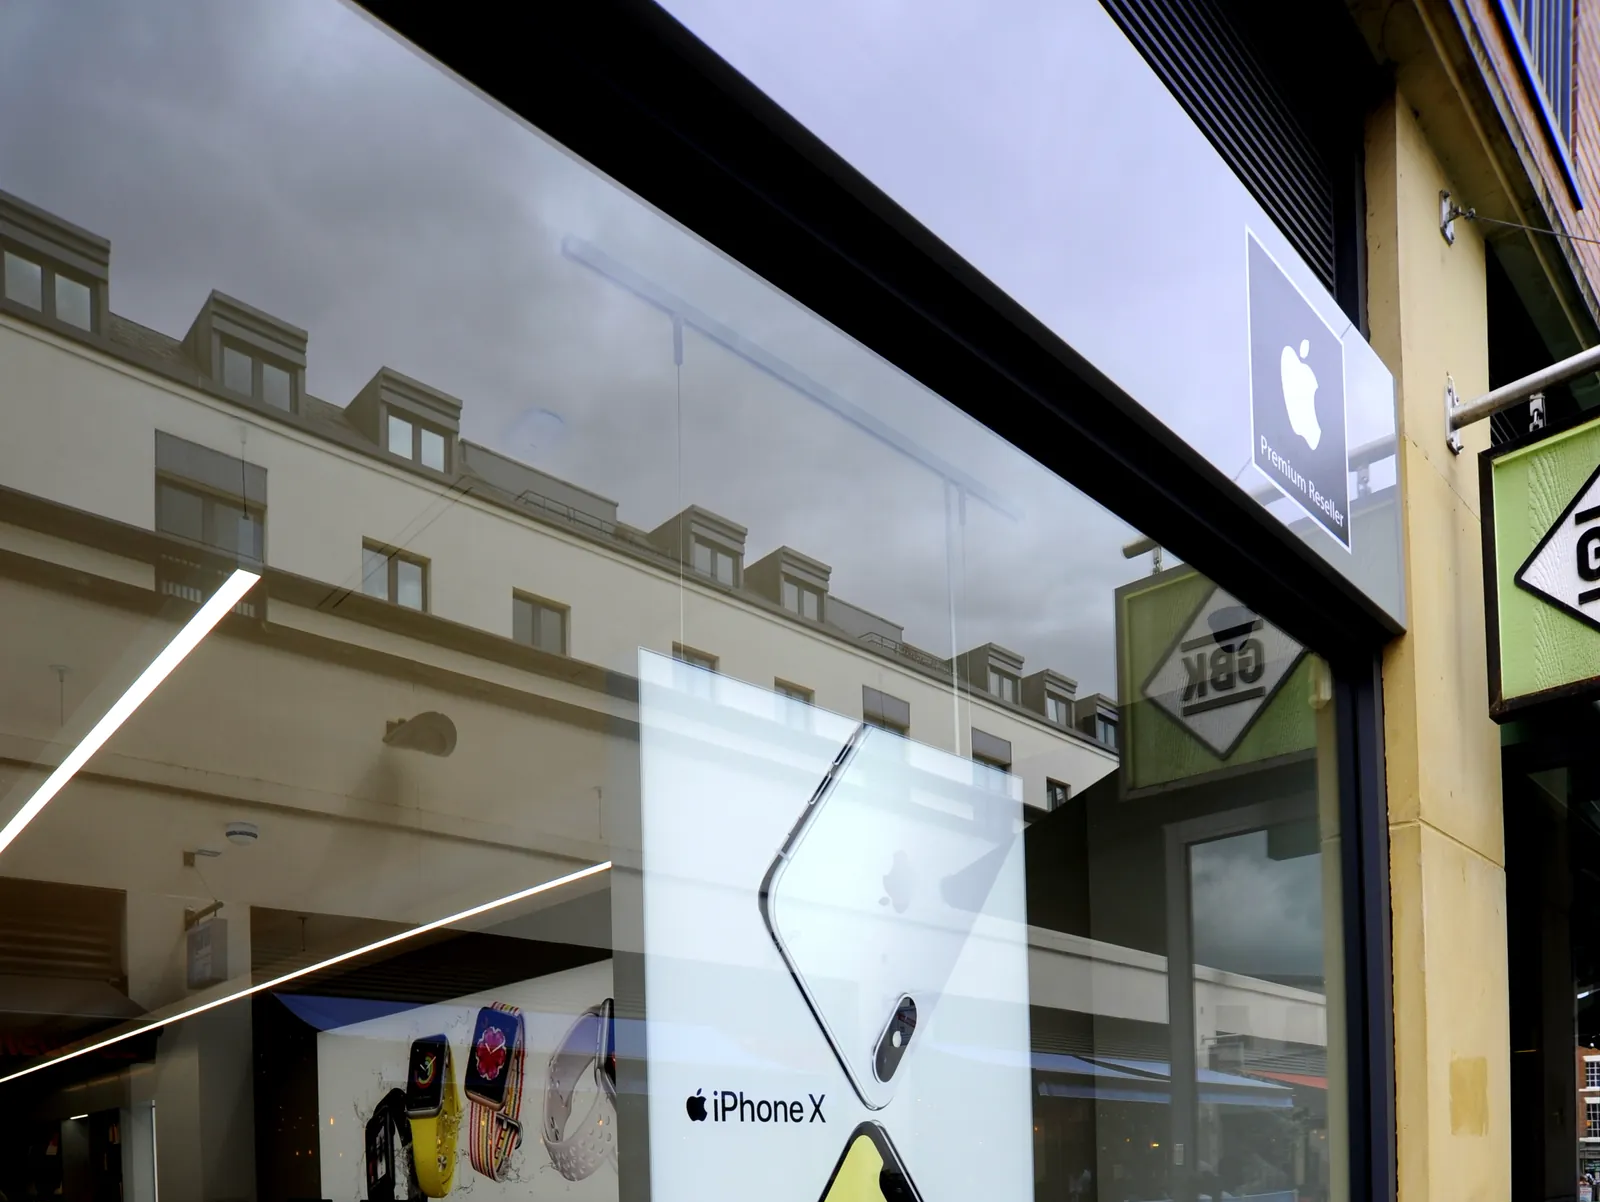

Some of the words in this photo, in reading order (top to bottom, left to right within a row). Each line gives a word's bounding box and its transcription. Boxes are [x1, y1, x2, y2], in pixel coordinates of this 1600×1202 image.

[1260, 434, 1307, 494] Premium
[1308, 479, 1344, 527] Reseller
[713, 1089, 804, 1123] iPhone
[808, 1093, 827, 1123] X
